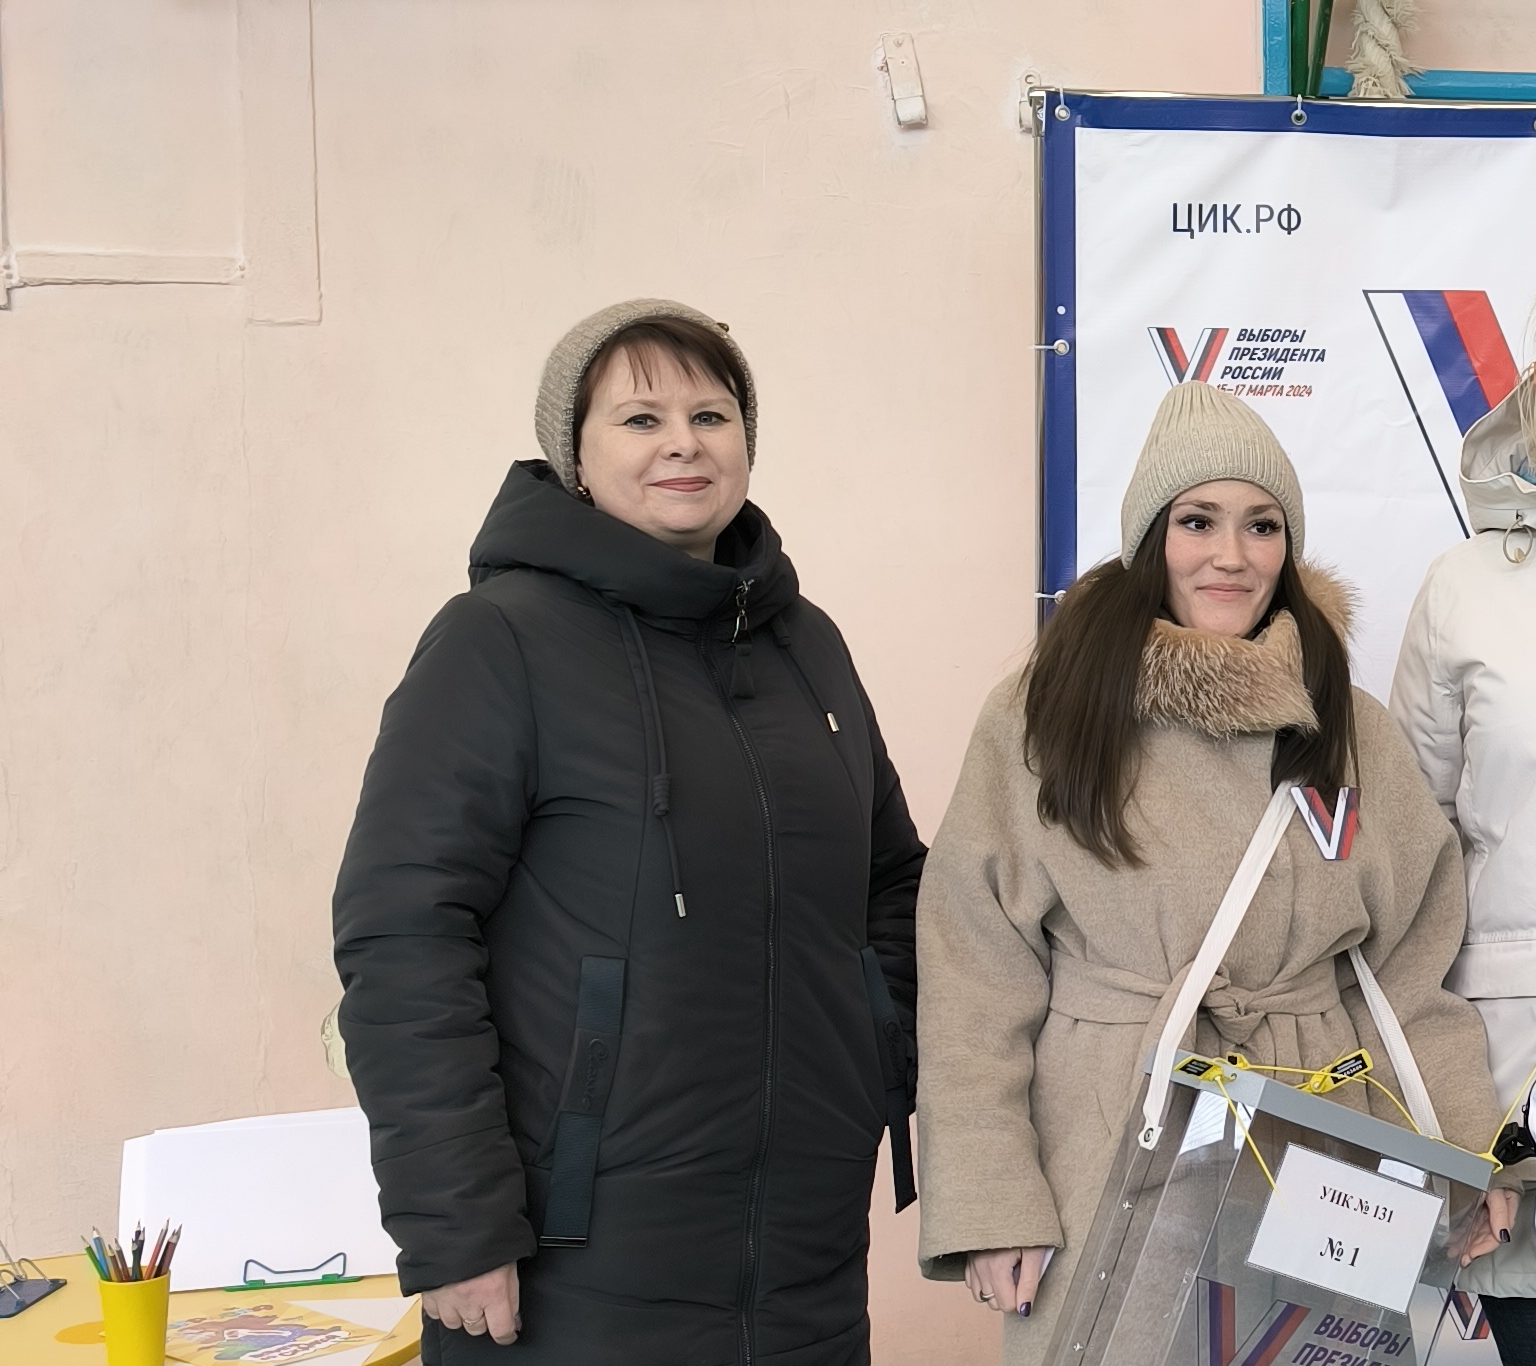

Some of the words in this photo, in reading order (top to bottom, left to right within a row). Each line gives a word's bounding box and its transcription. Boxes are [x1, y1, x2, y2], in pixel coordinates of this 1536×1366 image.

[1172, 202, 1302, 240] ЦИК.РФ
[1236, 328, 1306, 344] ВЫБОРЫ
[1228, 346, 1326, 364] ПРЕЗИДЕНТА
[1220, 365, 1284, 381] РОССИИ
[1246, 384, 1284, 397] МАРТА
[1285, 384, 1313, 398] 2024
[1320, 1185, 1354, 1210] УИК
[1373, 1204, 1394, 1223] 131
[1319, 1237, 1344, 1262] №
[1348, 1247, 1360, 1267] 1
[1314, 1313, 1410, 1357] ВЫБОРЫ
